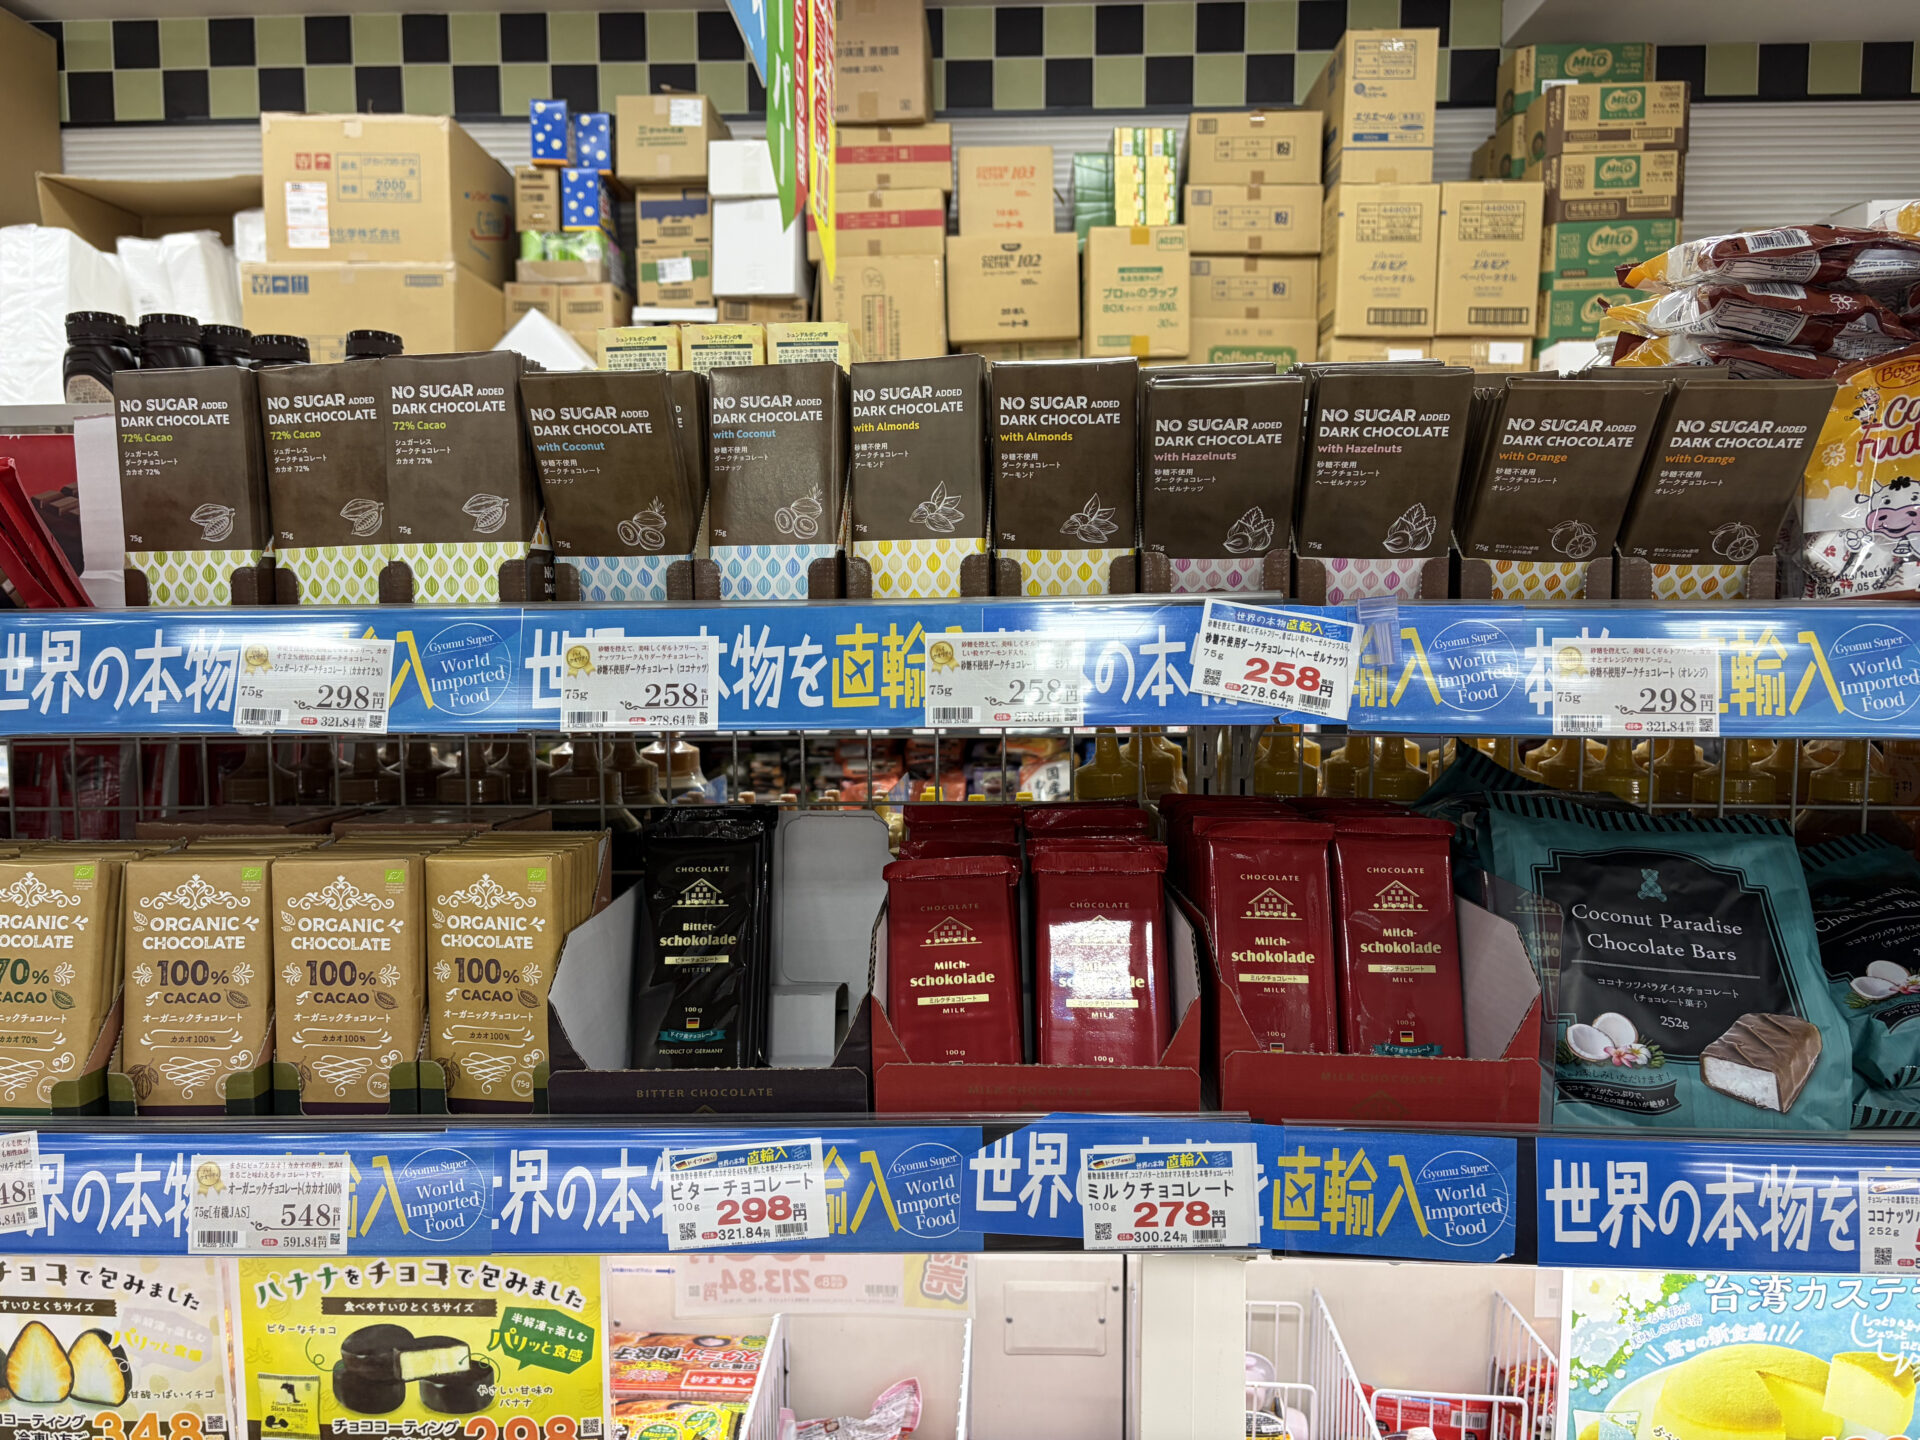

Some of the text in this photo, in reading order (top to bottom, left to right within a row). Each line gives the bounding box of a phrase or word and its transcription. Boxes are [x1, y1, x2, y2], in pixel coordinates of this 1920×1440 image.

[1572, 54, 1608, 69] MILO
[1611, 94, 1638, 105] MILO
[1605, 164, 1633, 175] MILO
[1596, 232, 1631, 247] MILO
[1017, 254, 1041, 267] 102
[120, 398, 228, 412] NO SUGAR ADDED
[713, 397, 736, 410] NO
[740, 395, 792, 408] SUGAR
[1000, 396, 1120, 410] NO SUGAR ADDED
[121, 414, 230, 428] DARK CHOCOLATE
[713, 411, 823, 424] DARK CHOCOLATE
[1000, 413, 1120, 426] DARK CHOCOLATE
[1321, 409, 1450, 422] NO SUGAR ADDED
[1319, 426, 1449, 437] DARK CHOCOLATE
[1675, 420, 1807, 434] NO SUGAR ADDED
[122, 433, 173, 443] 72% Cacao
[713, 429, 776, 440] with Coconut
[1000, 432, 1073, 442] with Almonds
[1318, 444, 1402, 453] with Hazelnuts
[1670, 437, 1805, 449] DARK CHOCOLATE
[124, 450, 159, 458] シュガーレス
[714, 454, 768, 462] ダークチョコレート
[1665, 454, 1735, 466] with Orange
[125, 457, 178, 466] ダークチョコレート
[1316, 469, 1380, 477] ダークチョコレート
[130, 534, 142, 543] 75g
[1308, 542, 1322, 550] 75g
[429, 632, 494, 654] Gyomu Super
[1203, 648, 1224, 661] 75g
[440, 653, 490, 675] World
[429, 665, 506, 693] Imported
[1244, 658, 1321, 692] 258
[241, 684, 369, 709] 75g 298
[449, 687, 490, 708] Food
[565, 683, 697, 707] 75g 258
[929, 679, 1061, 703] 75g 258
[1241, 684, 1286, 700] 278.64
[1557, 688, 1696, 713] 75g 298
[321, 717, 356, 728] 321.84
[650, 716, 686, 726] 278.64
[1646, 721, 1684, 733] 321.84
[920, 903, 980, 912] CHOCOLATE
[150, 916, 239, 932] ORGANIC
[682, 922, 716, 931] Bitter-
[1571, 903, 1743, 936] Coconut Paradise
[142, 936, 246, 950] CHOCOLATE
[659, 934, 737, 947] schokolade
[1587, 933, 1737, 961] Chocolate Bars
[933, 960, 970, 970] Milch-
[157, 960, 229, 986] 100%
[910, 972, 996, 987] schokolade
[1597, 977, 1740, 999] ココナッツパラダイスチョコレート
[163, 992, 221, 1004] CACAO
[142, 1013, 243, 1024] オーガニックチョコレート
[1660, 1015, 1690, 1031] 252g
[636, 1088, 774, 1098] BITTER CHOCOLATE
[404, 1158, 468, 1178] Gyomu Super
[416, 1178, 465, 1199] World
[671, 1172, 813, 1200] ビターチョコレート
[1088, 1179, 1234, 1200] ミルクチョコレート
[406, 1191, 480, 1218] Imported
[673, 1195, 792, 1226] 100g 298
[281, 1204, 330, 1227] 548
[1088, 1201, 1211, 1227] 100g 278
[425, 1214, 465, 1233] Food
[718, 1226, 762, 1240] 321.84
[1134, 1231, 1179, 1243] 300.24
[1869, 1227, 1900, 1237] 252g
[283, 1237, 318, 1247] 591.84
[344, 1302, 474, 1314] 食べやすいひとくちサイズ
[500, 1398, 532, 1408] バナナ
[333, 1419, 460, 1435] チョココーティング
